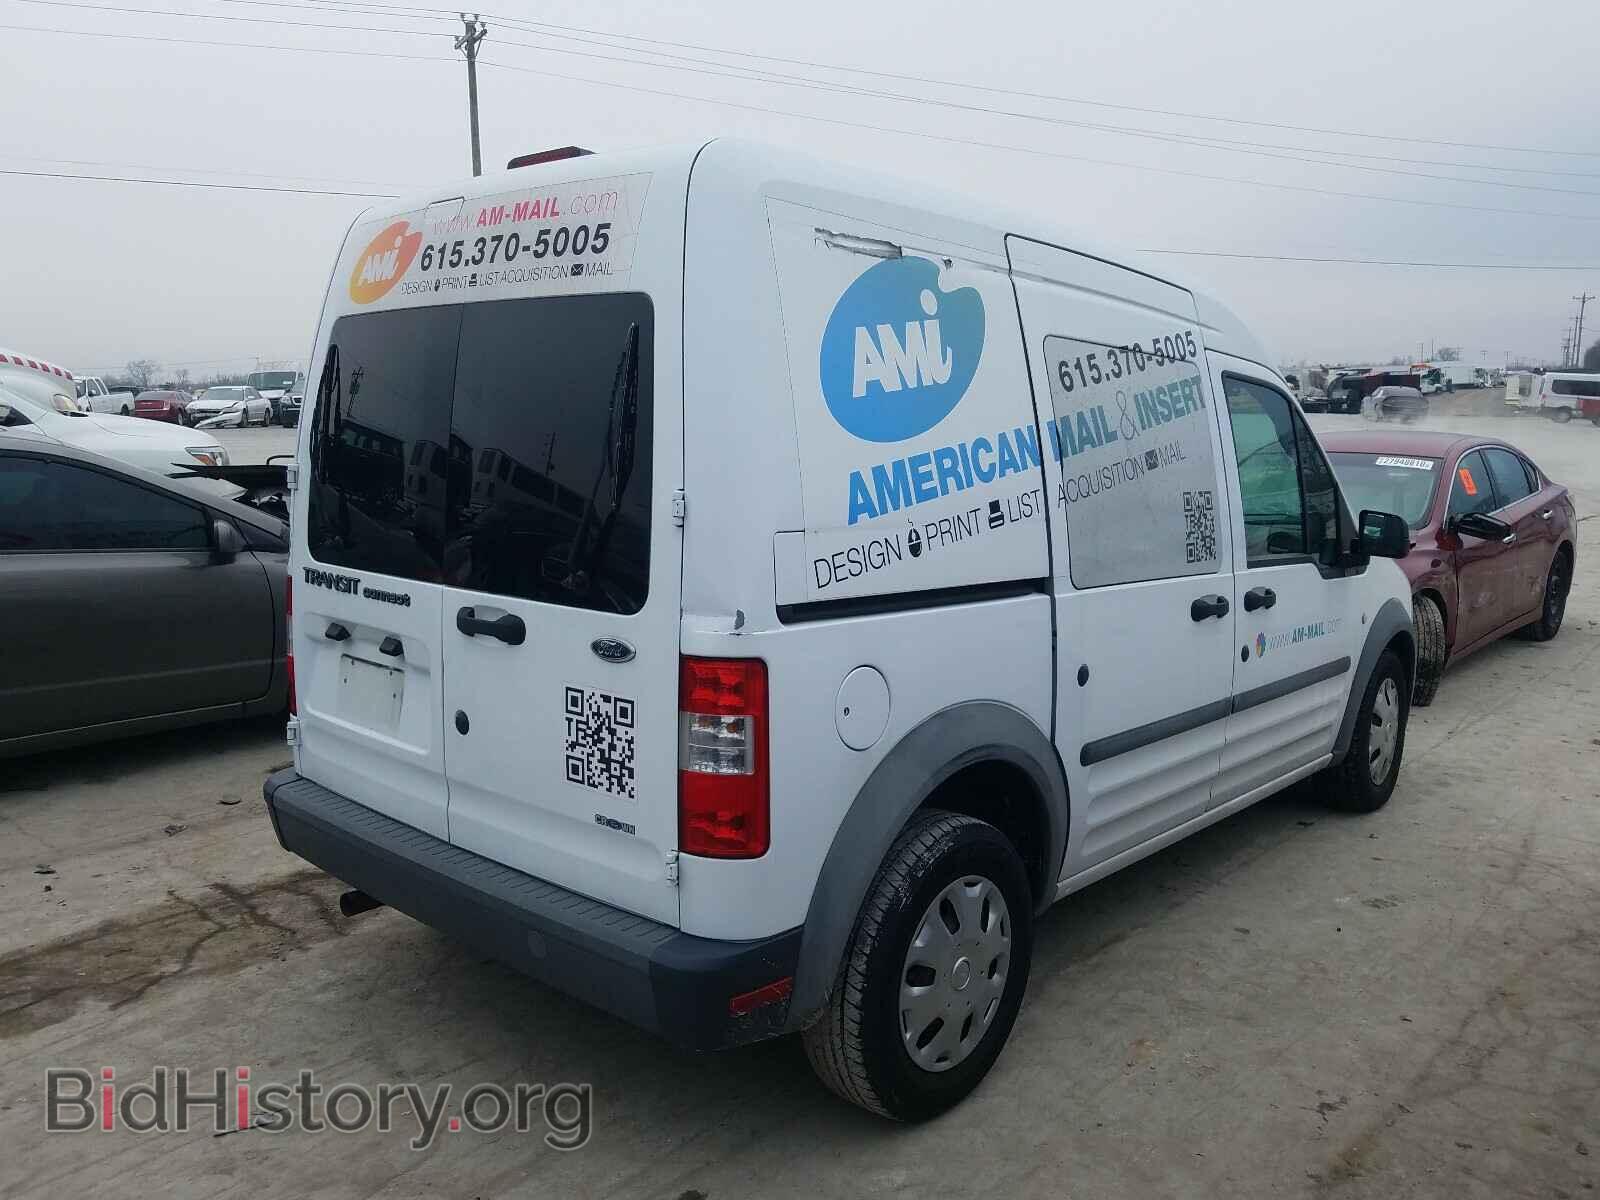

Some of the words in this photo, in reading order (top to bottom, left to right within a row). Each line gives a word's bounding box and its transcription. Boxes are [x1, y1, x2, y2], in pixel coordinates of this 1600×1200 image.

[420, 222, 611, 271] 615.370-5005
[401, 280, 433, 295] DESIGN
[441, 275, 469, 289] PRINT
[479, 271, 500, 287] LIST
[500, 265, 569, 285] ACQUISITION
[584, 262, 614, 276] MAIL
[1057, 330, 1198, 393] 615.370-5005
[847, 424, 1042, 526] AMERICAN
[1046, 405, 1119, 463] MAIL
[1116, 389, 1138, 441] &
[1133, 374, 1207, 432] INSERT
[813, 534, 902, 589] DESIGN
[924, 507, 982, 550] PRINT
[1008, 487, 1042, 523] LIST
[1056, 452, 1147, 509] ACQUISITION
[1158, 440, 1188, 474] MAIL
[303, 567, 361, 595] TRANSIT
